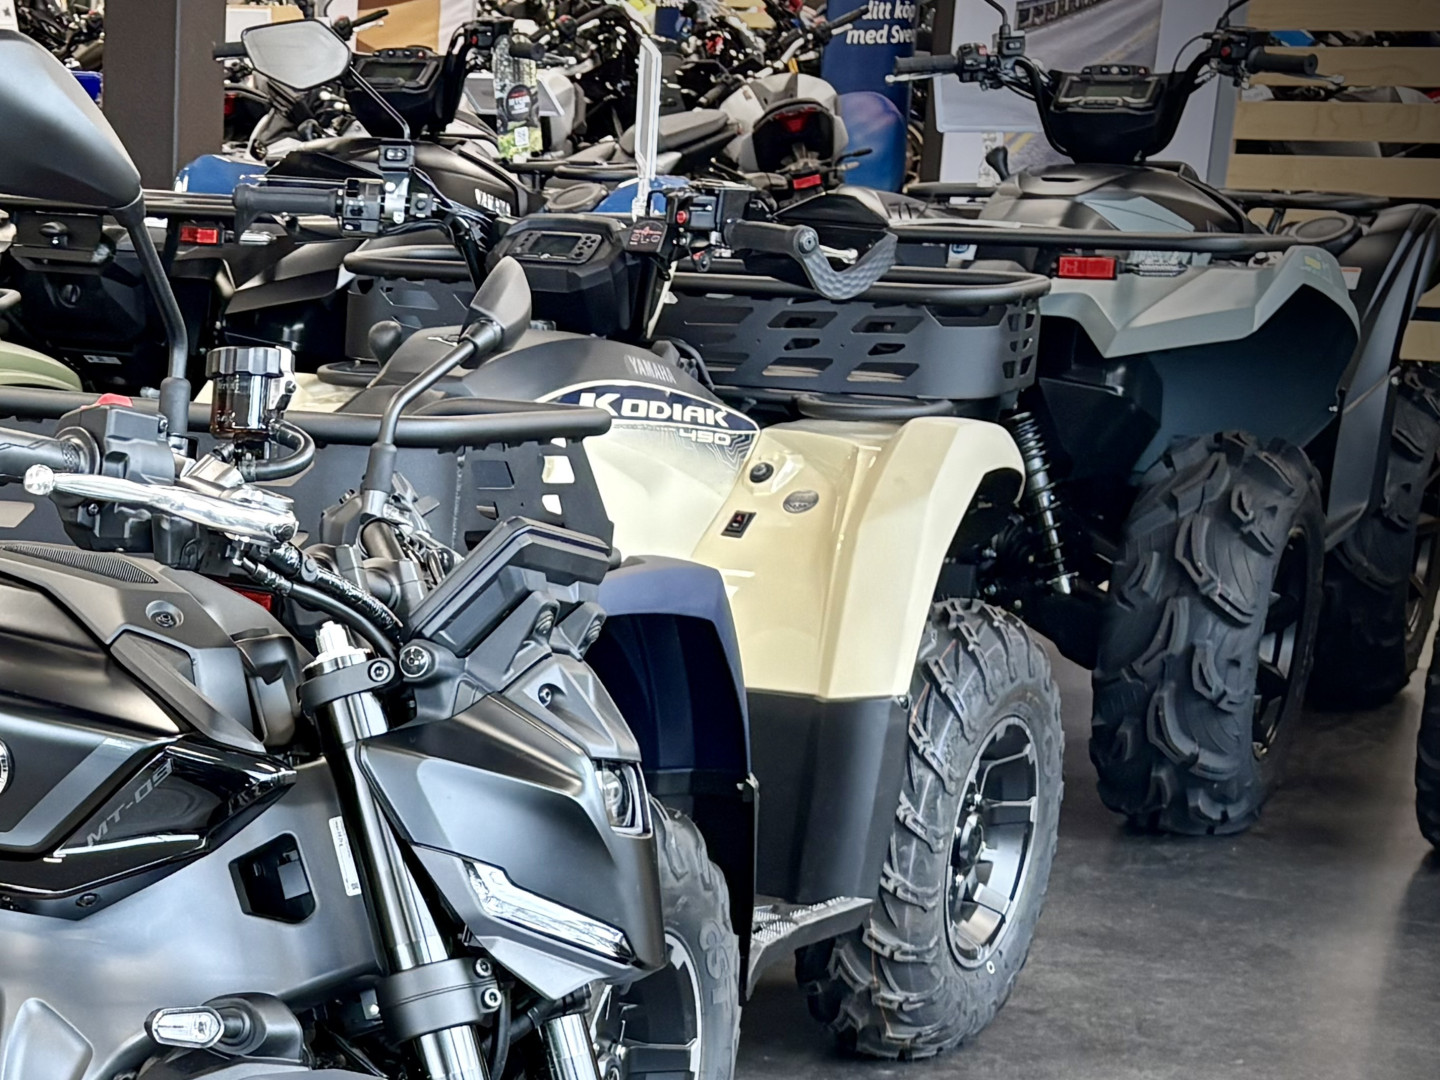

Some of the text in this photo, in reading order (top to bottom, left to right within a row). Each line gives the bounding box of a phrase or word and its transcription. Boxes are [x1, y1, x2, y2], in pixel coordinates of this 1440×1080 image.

[846, 24, 889, 45] med
[626, 355, 677, 384] YAMAHA
[579, 392, 730, 428] KODIAK
[86, 758, 175, 847] MT-09
